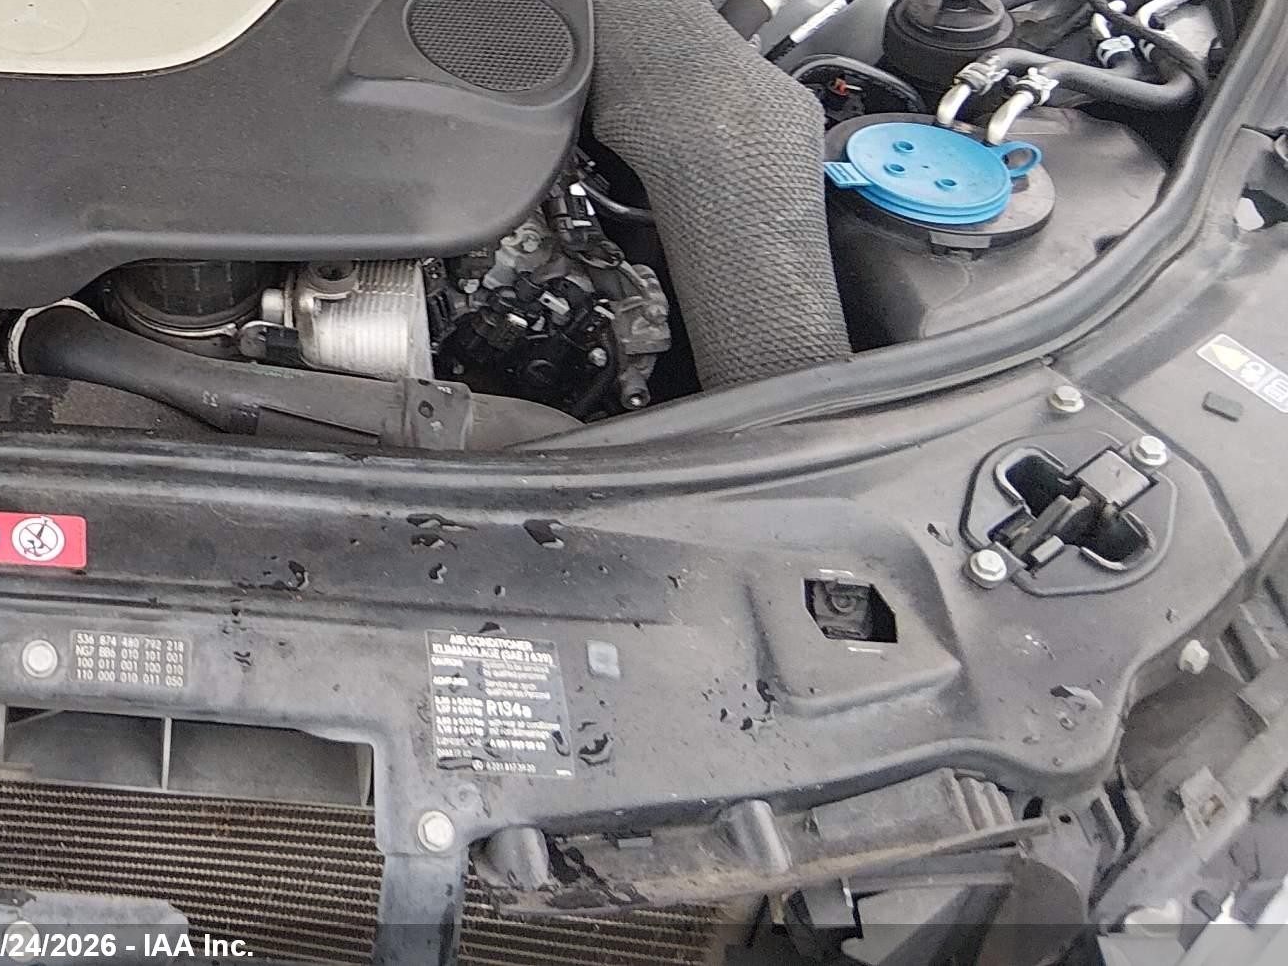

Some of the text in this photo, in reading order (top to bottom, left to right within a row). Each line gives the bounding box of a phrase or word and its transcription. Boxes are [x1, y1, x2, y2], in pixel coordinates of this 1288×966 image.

[99, 634, 117, 647] 874
[450, 634, 534, 652] AIR CONDITIONER
[75, 645, 95, 657] NG7
[121, 648, 139, 660] 010
[145, 650, 161, 662] 101
[165, 652, 183, 664] 001
[432, 643, 501, 660] KLIMAANLAGE
[501, 650, 523, 662] (SAE
[77, 657, 184, 675] 100 011 001 100 010
[76, 669, 184, 687] 110 000 010 011 050
[486, 700, 532, 718] R134a
